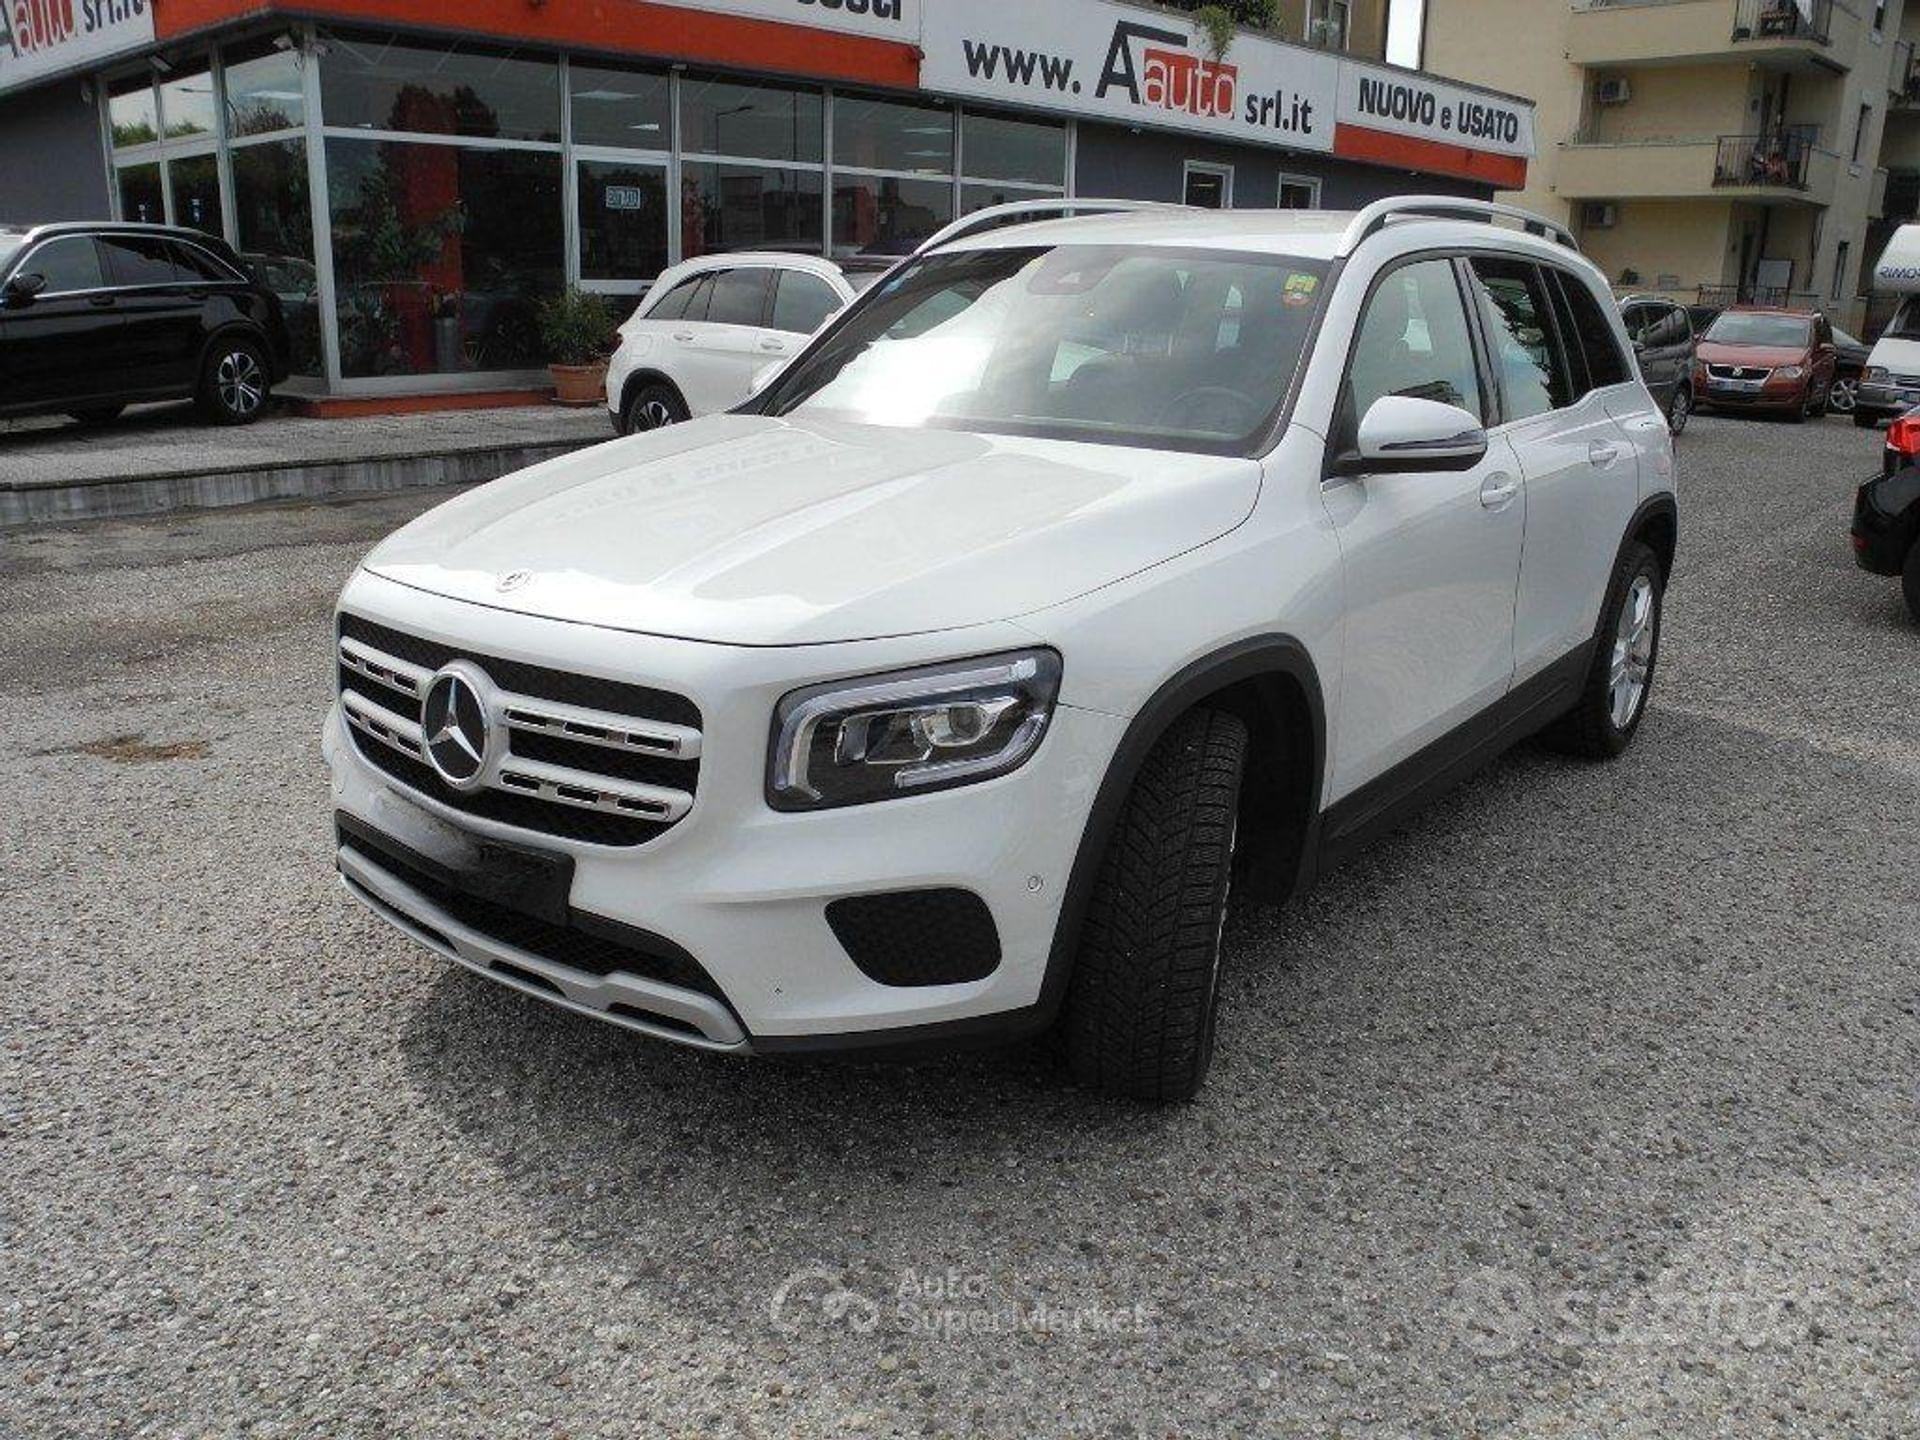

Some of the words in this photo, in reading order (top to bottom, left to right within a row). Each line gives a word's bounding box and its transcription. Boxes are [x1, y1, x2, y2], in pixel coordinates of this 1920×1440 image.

[963, 39, 1081, 94] www.
[1245, 89, 1313, 134] srl.it
[1358, 77, 1436, 126] NUOVO
[1440, 106, 1452, 130] e
[1457, 101, 1519, 143] USATO
